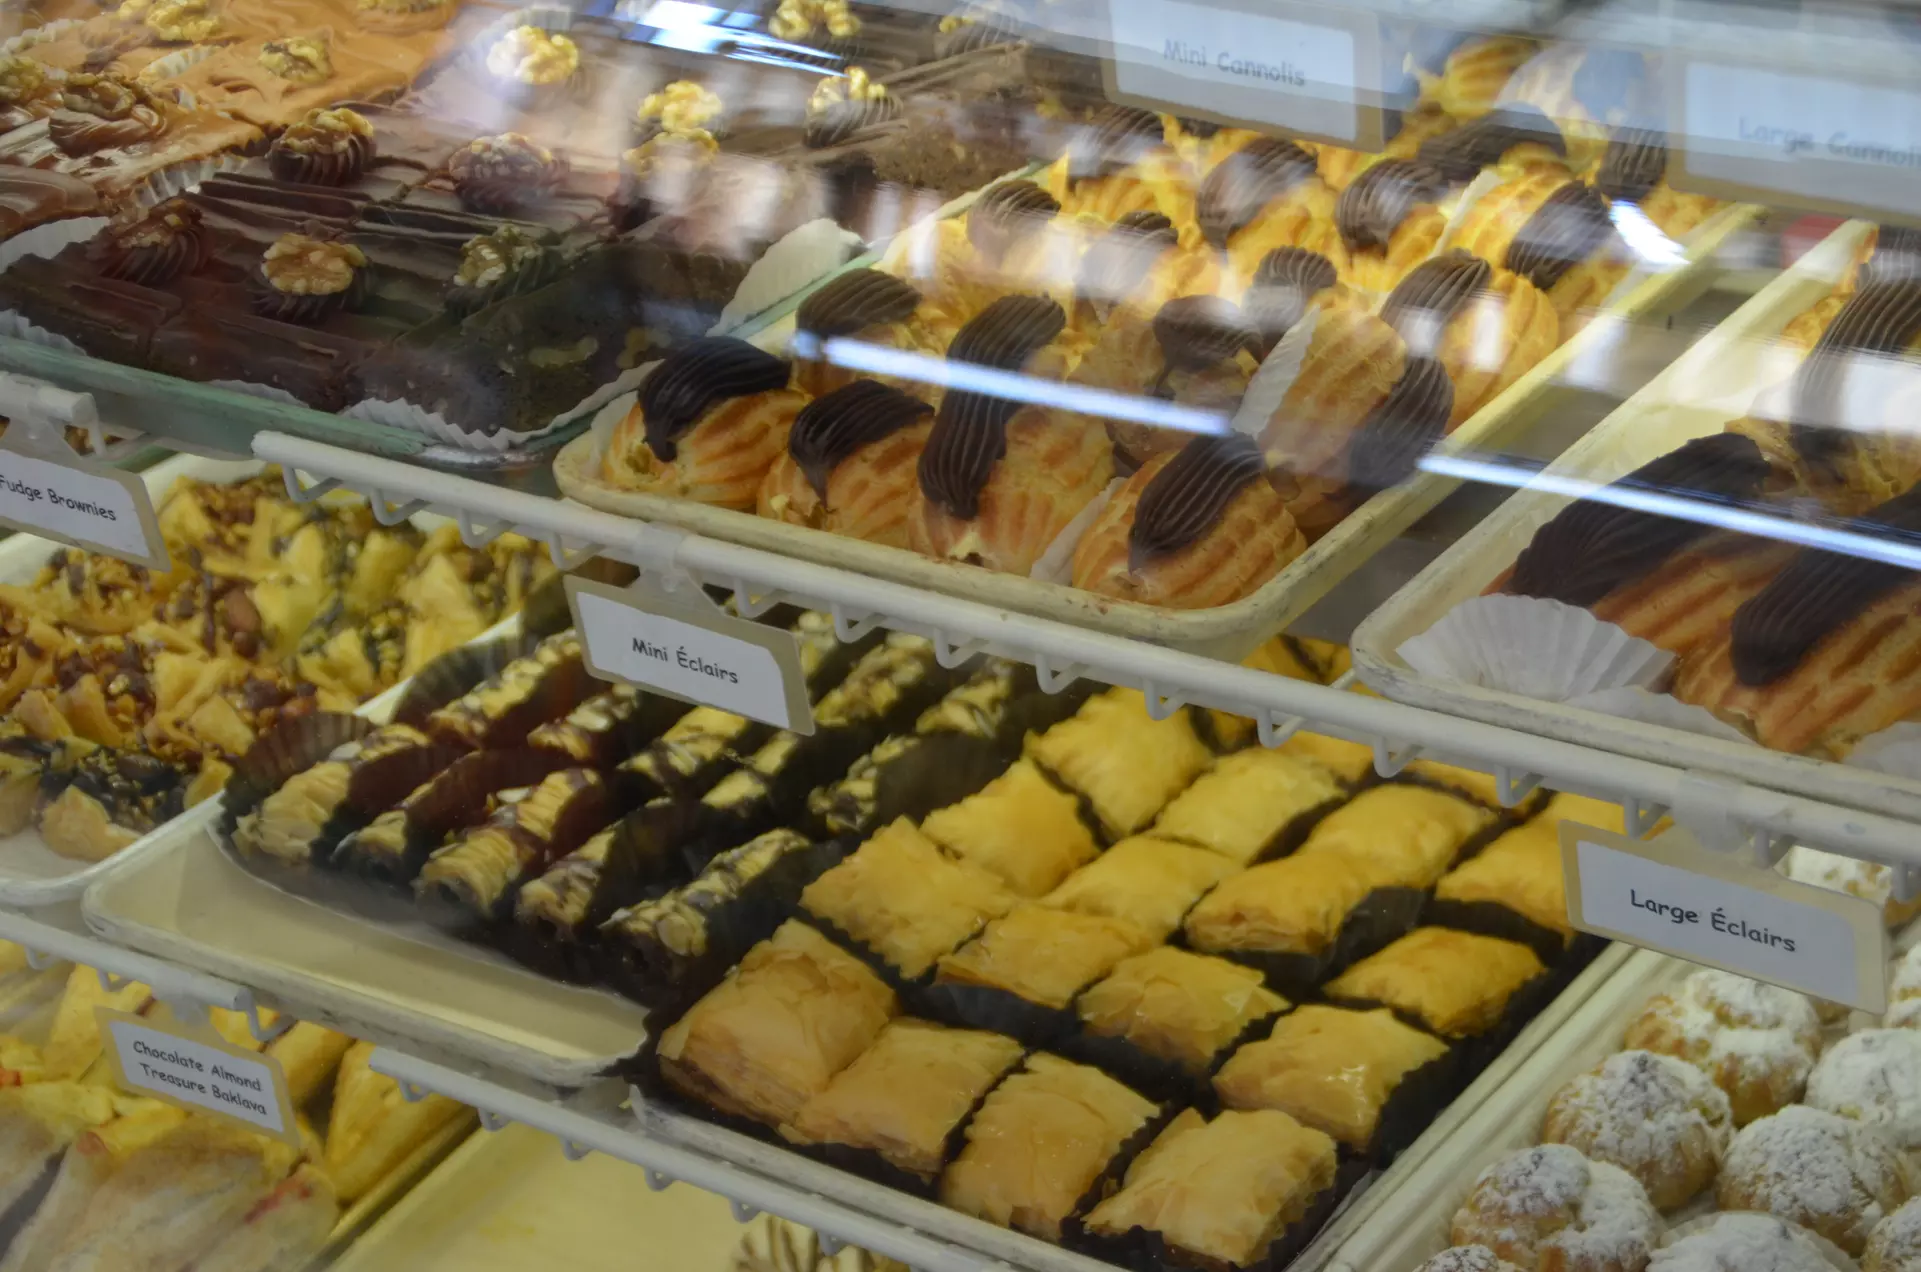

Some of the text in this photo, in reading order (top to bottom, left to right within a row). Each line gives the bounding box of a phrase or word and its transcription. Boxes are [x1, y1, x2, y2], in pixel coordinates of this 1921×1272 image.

[1163, 38, 1306, 87] Mini Cannolis
[1737, 115, 1814, 156] Large
[47, 488, 117, 521] Brownies
[632, 637, 739, 684] Mini Éclairs
[1630, 889, 1796, 952] Large Éclairs
[133, 1040, 262, 1092] Chocolate Almond
[139, 1062, 267, 1115] Treasure Baklava
